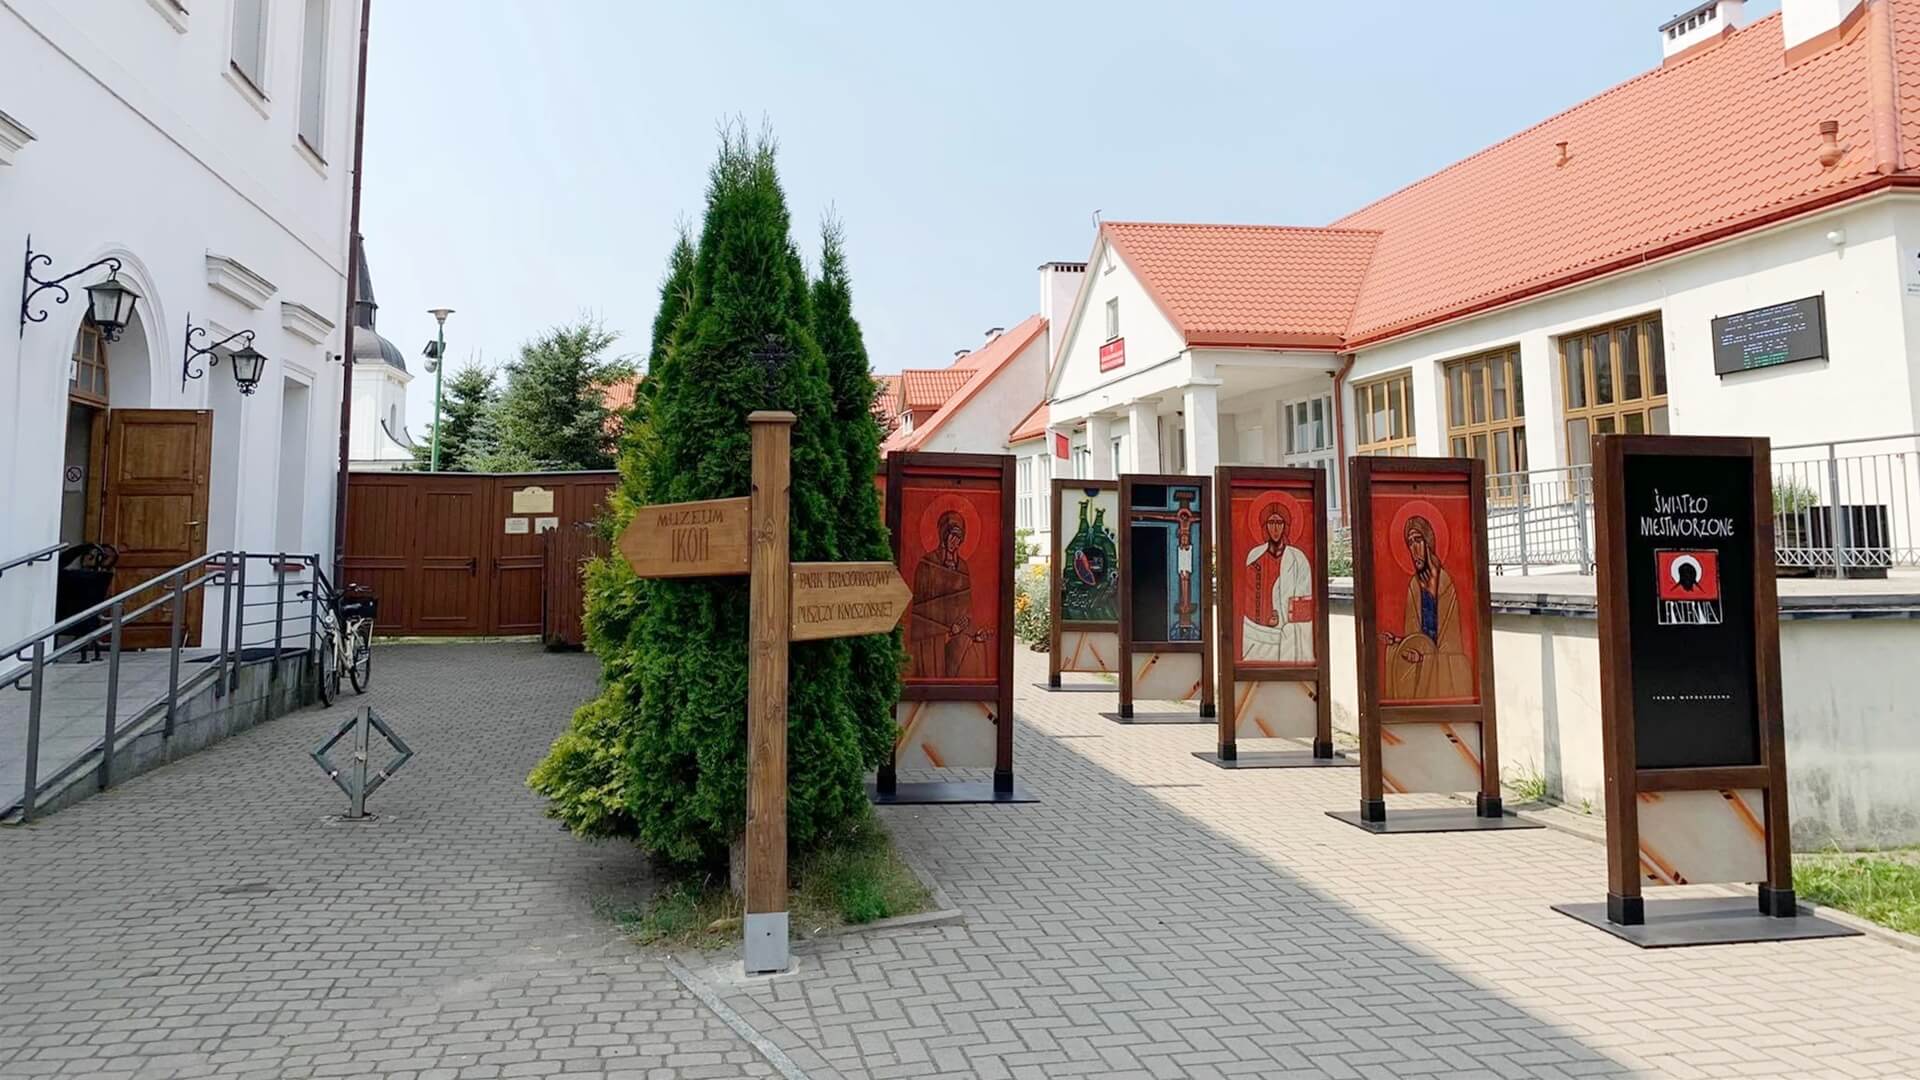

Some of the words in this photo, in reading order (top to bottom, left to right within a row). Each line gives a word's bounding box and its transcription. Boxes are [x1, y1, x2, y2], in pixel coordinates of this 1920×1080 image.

[1654, 488, 1709, 514] ŚWIATŁO
[656, 509, 723, 527] MUZEUM
[1640, 516, 1735, 538] NIESTWORZONE
[799, 572, 823, 589] PARK
